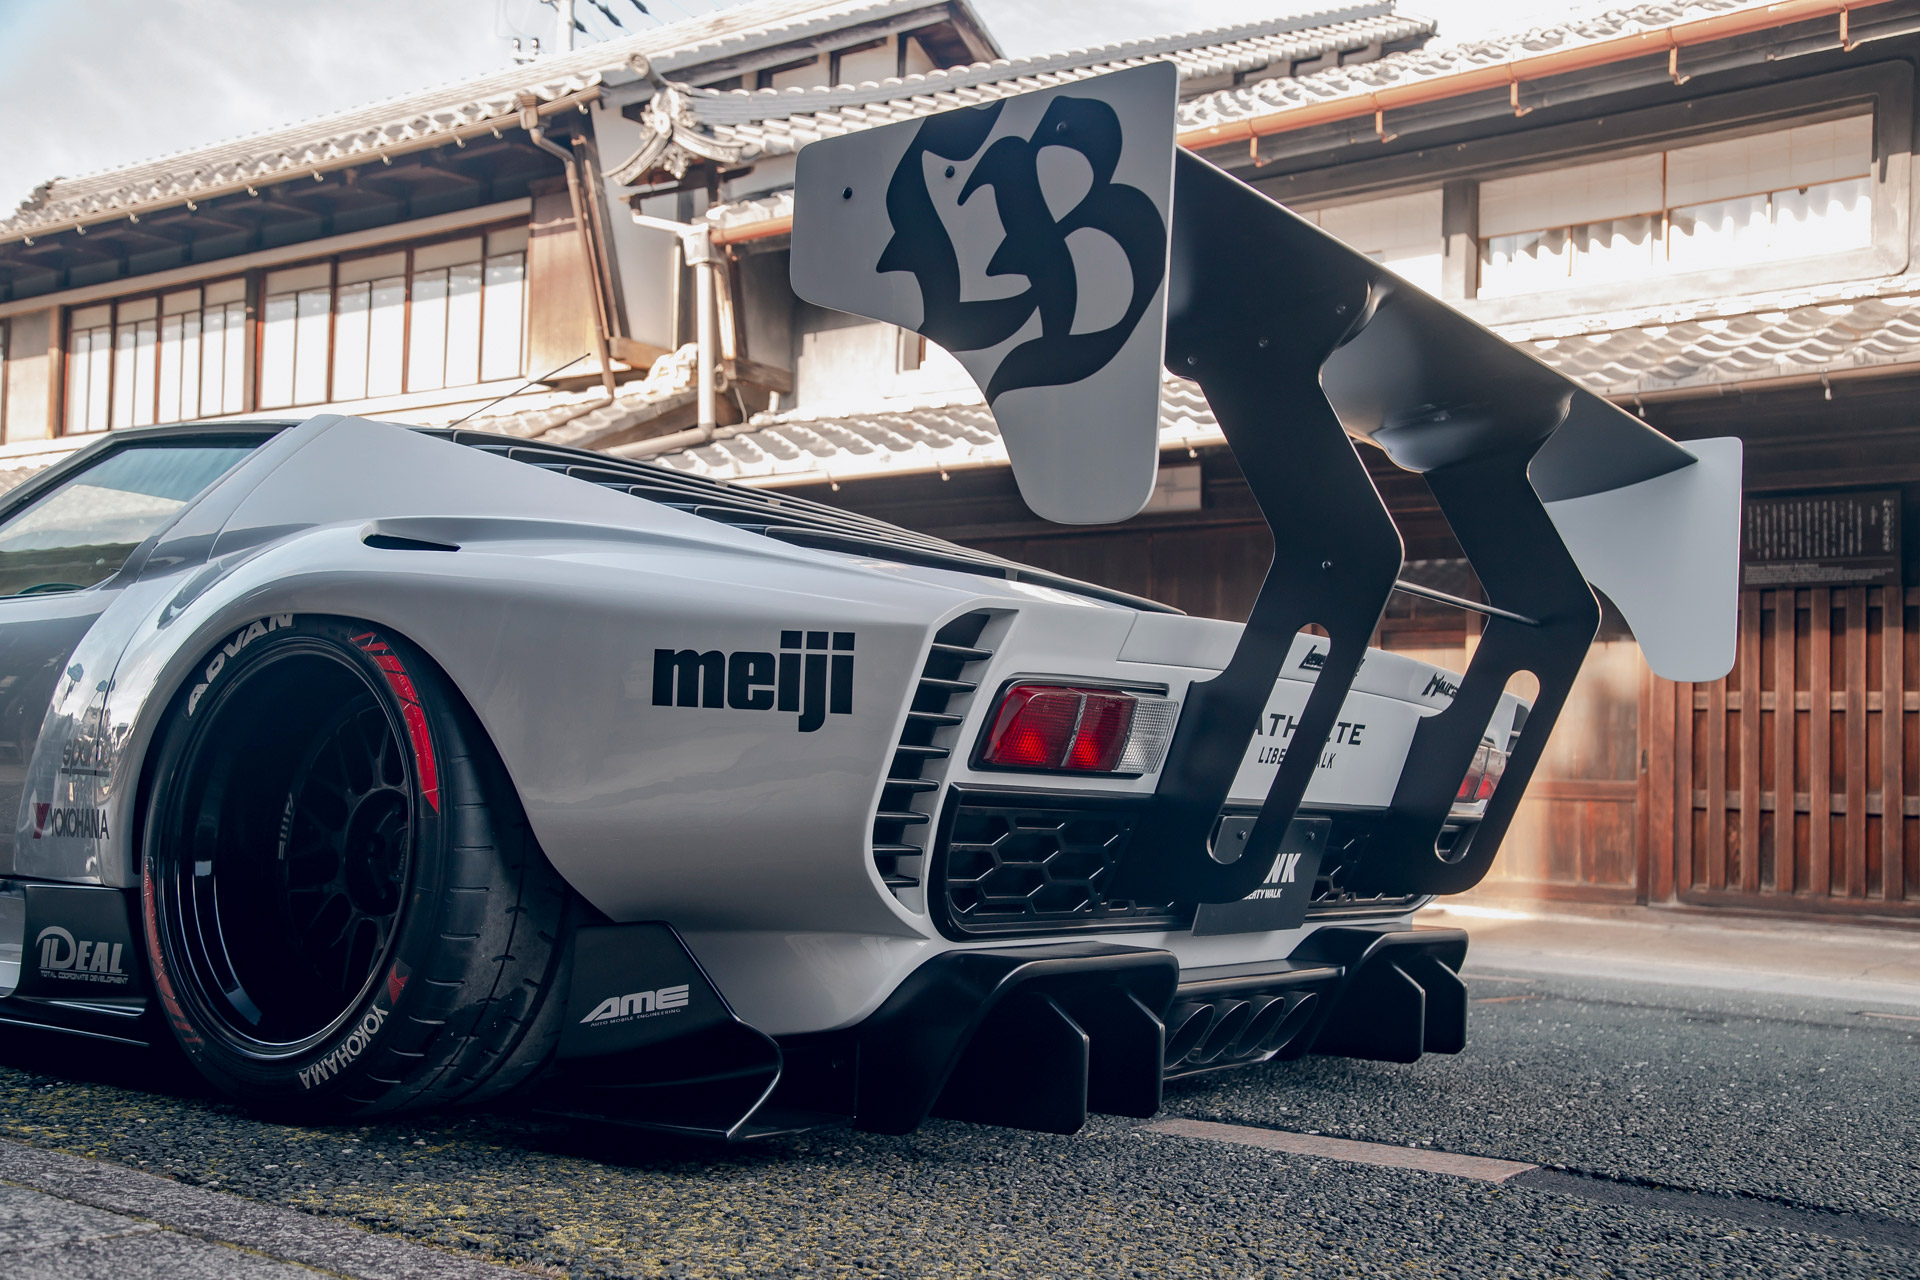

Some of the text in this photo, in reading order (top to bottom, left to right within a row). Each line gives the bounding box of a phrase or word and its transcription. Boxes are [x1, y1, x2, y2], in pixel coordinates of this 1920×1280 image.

[188, 613, 294, 717] ADVAN
[652, 630, 856, 733] meiji
[1255, 713, 1366, 746] ATHTE
[50, 808, 110, 840] YOKOHAMA
[1264, 888, 1283, 899] WALK
[35, 926, 123, 974] IDEAL
[40, 970, 57, 978] TOTAL
[579, 984, 690, 1024] AME
[609, 1016, 634, 1024] MOBILE
[637, 1009, 681, 1019] ENGINEERING
[298, 1004, 389, 1090] YOKOHAMA
